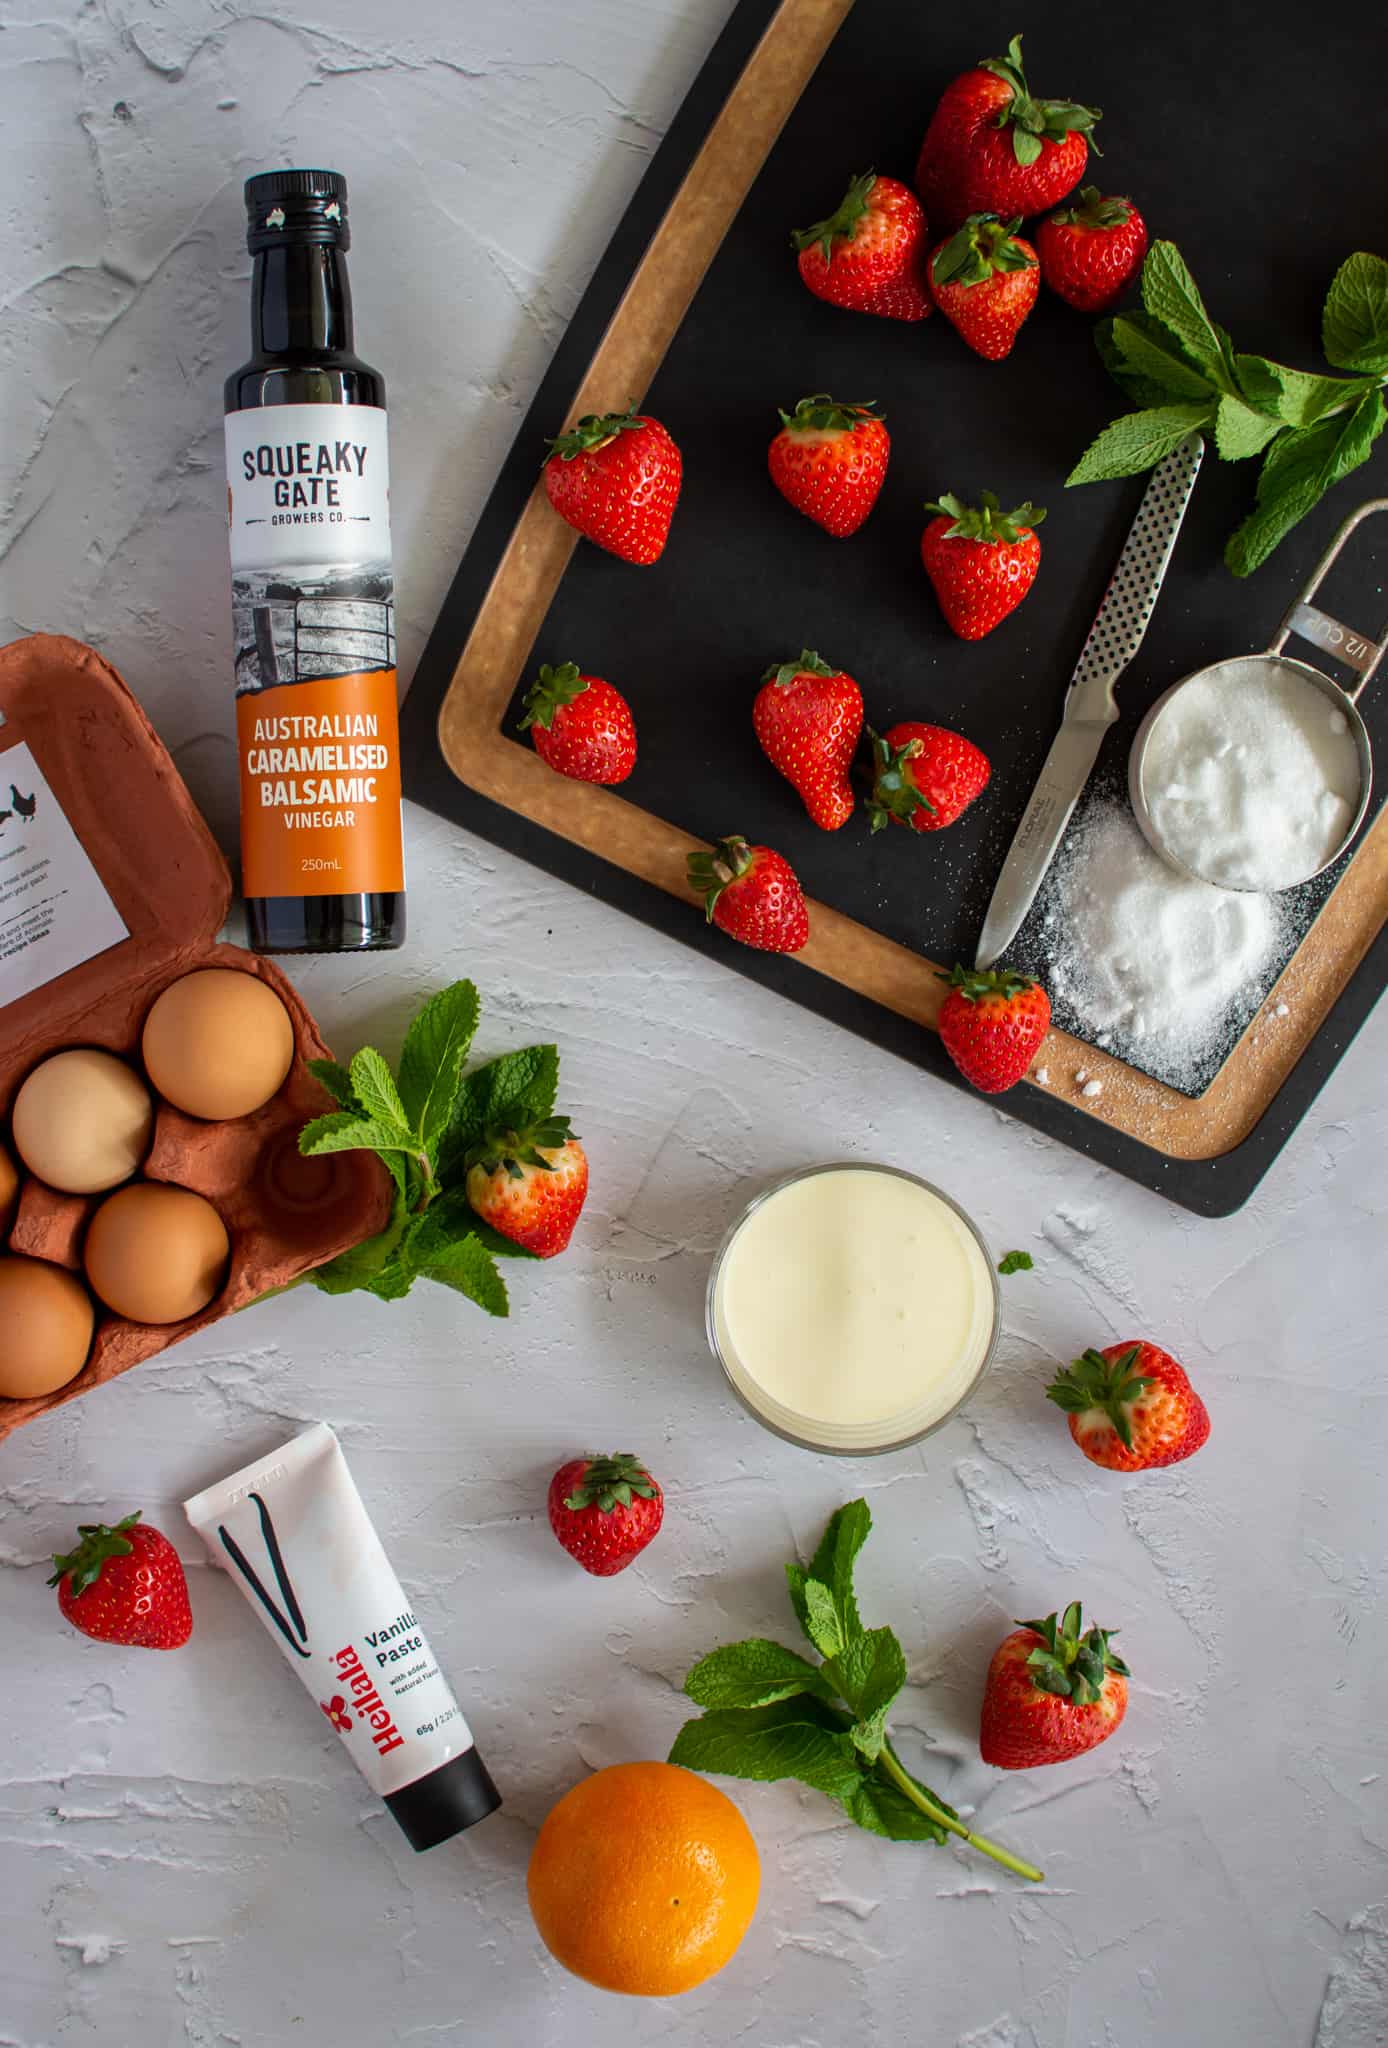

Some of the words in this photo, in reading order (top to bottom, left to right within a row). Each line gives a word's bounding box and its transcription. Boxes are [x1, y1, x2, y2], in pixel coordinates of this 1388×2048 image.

[243, 441, 369, 481] SQUEAKY
[275, 477, 340, 508] GATE
[272, 512, 324, 526] GROWERS
[329, 511, 347, 523] CO.
[1345, 637, 1368, 659] 1/2
[254, 714, 378, 742] AUSTRALIAN
[247, 744, 388, 775] CARAMELISED
[261, 777, 378, 807] BALSAMIC
[284, 810, 356, 829] VINEGAR
[301, 858, 343, 872] 250mL
[375, 1635, 423, 1668] Paste
[389, 1671, 408, 1686] with
[335, 1644, 405, 1756] Heilala
[416, 1723, 435, 1737] 65g
